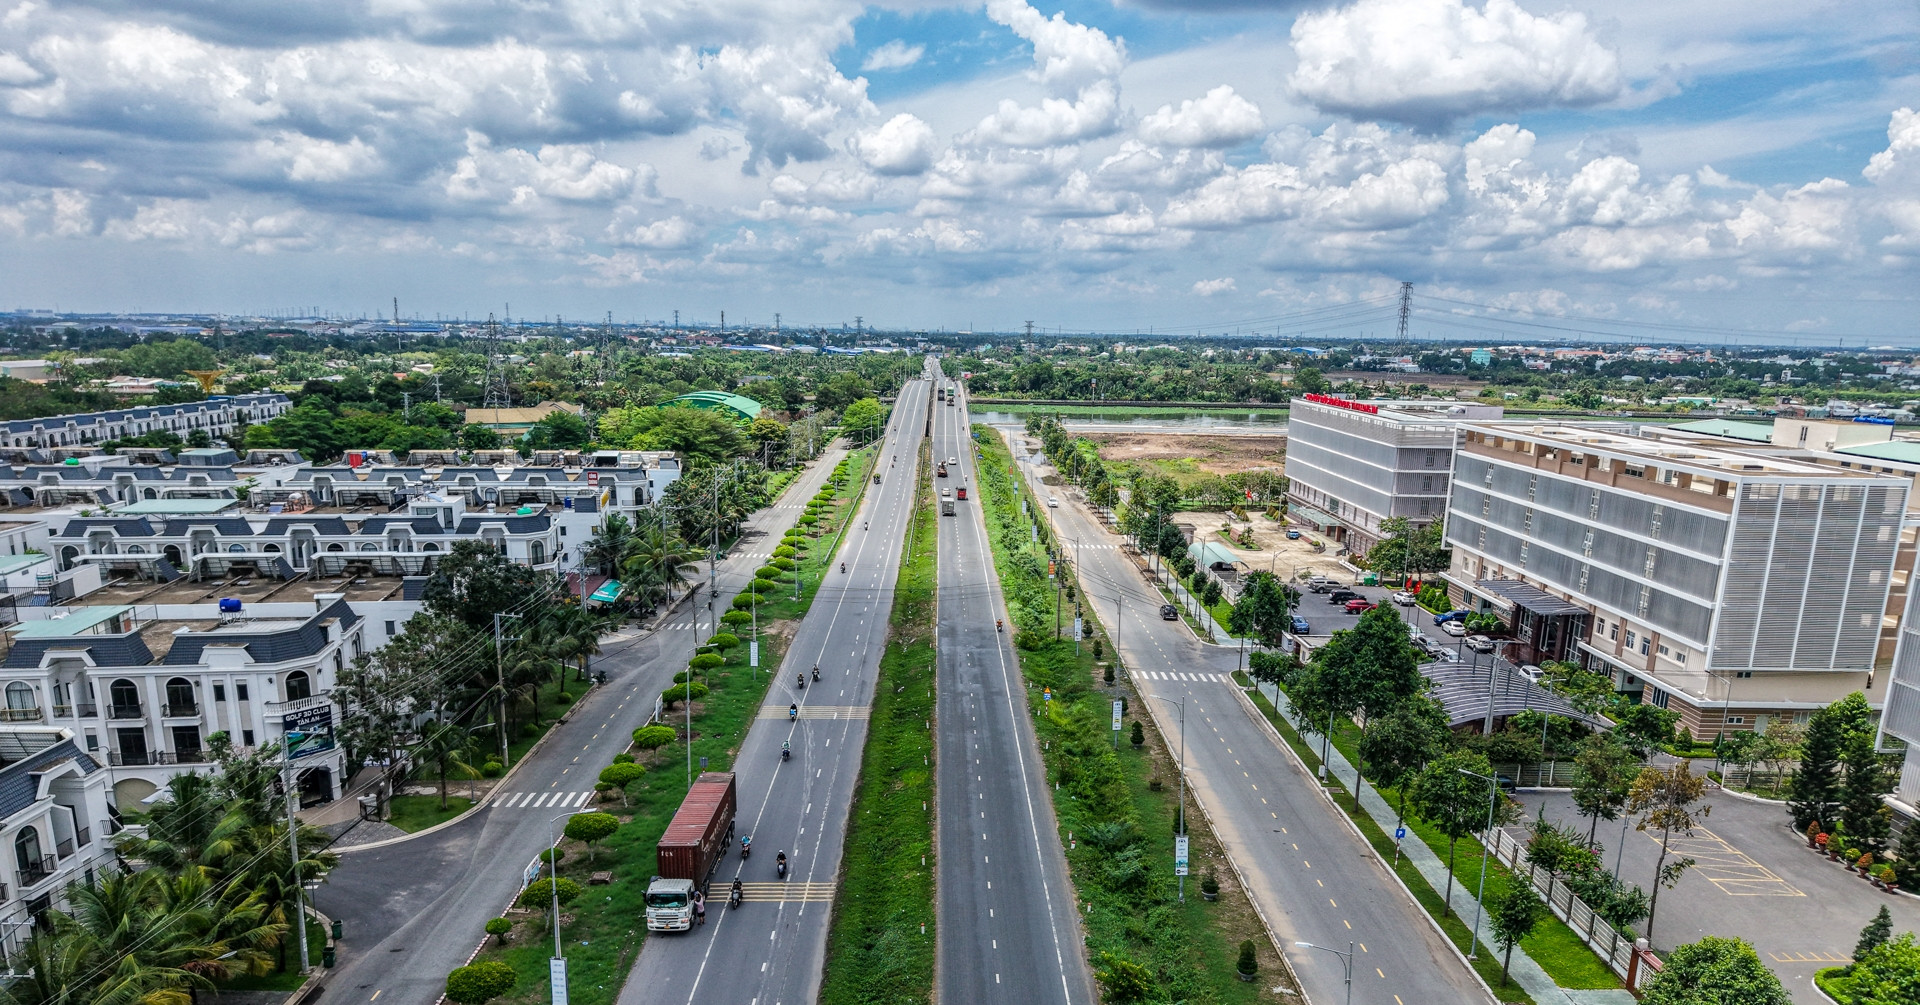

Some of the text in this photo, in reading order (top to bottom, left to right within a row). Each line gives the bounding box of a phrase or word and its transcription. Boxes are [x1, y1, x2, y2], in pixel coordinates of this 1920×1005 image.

[285, 706, 329, 721] GOLF 3D CLUB
[310, 715, 320, 723] AN
